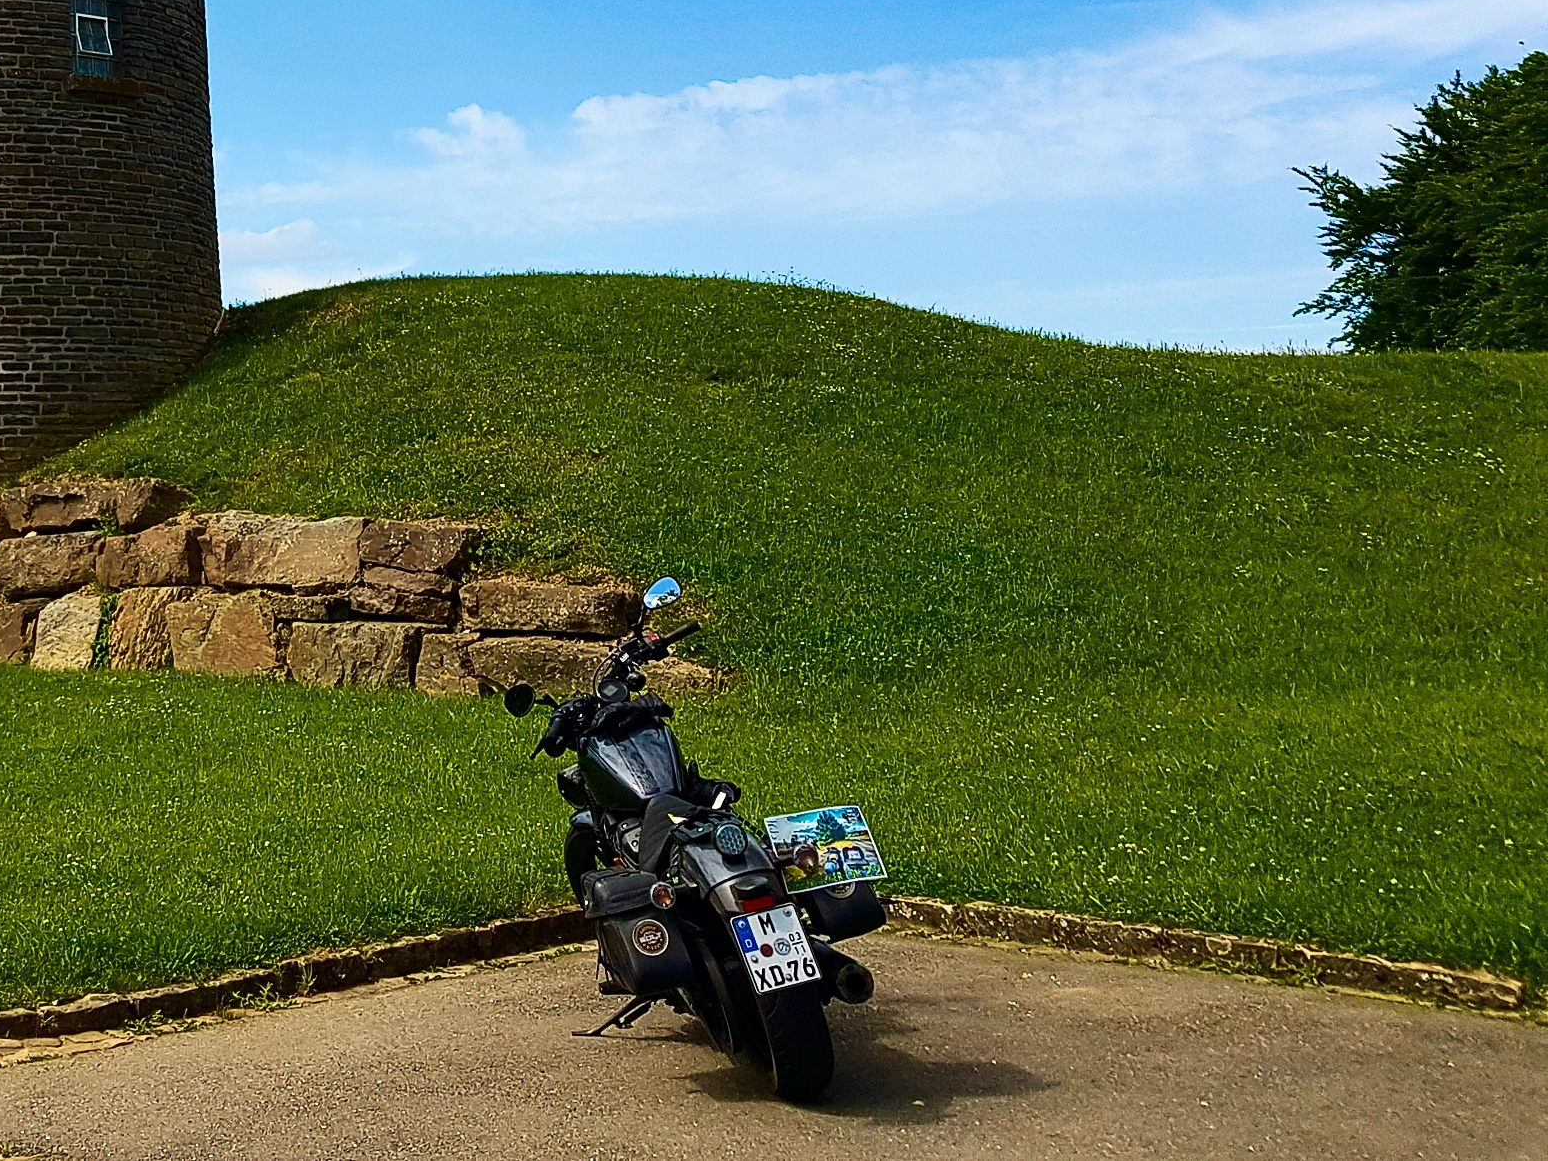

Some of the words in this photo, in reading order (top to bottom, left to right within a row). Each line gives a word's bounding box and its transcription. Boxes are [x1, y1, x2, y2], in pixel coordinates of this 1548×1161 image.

[757, 912, 776, 936] M
[788, 932, 802, 942] 03
[744, 939, 753, 948] D
